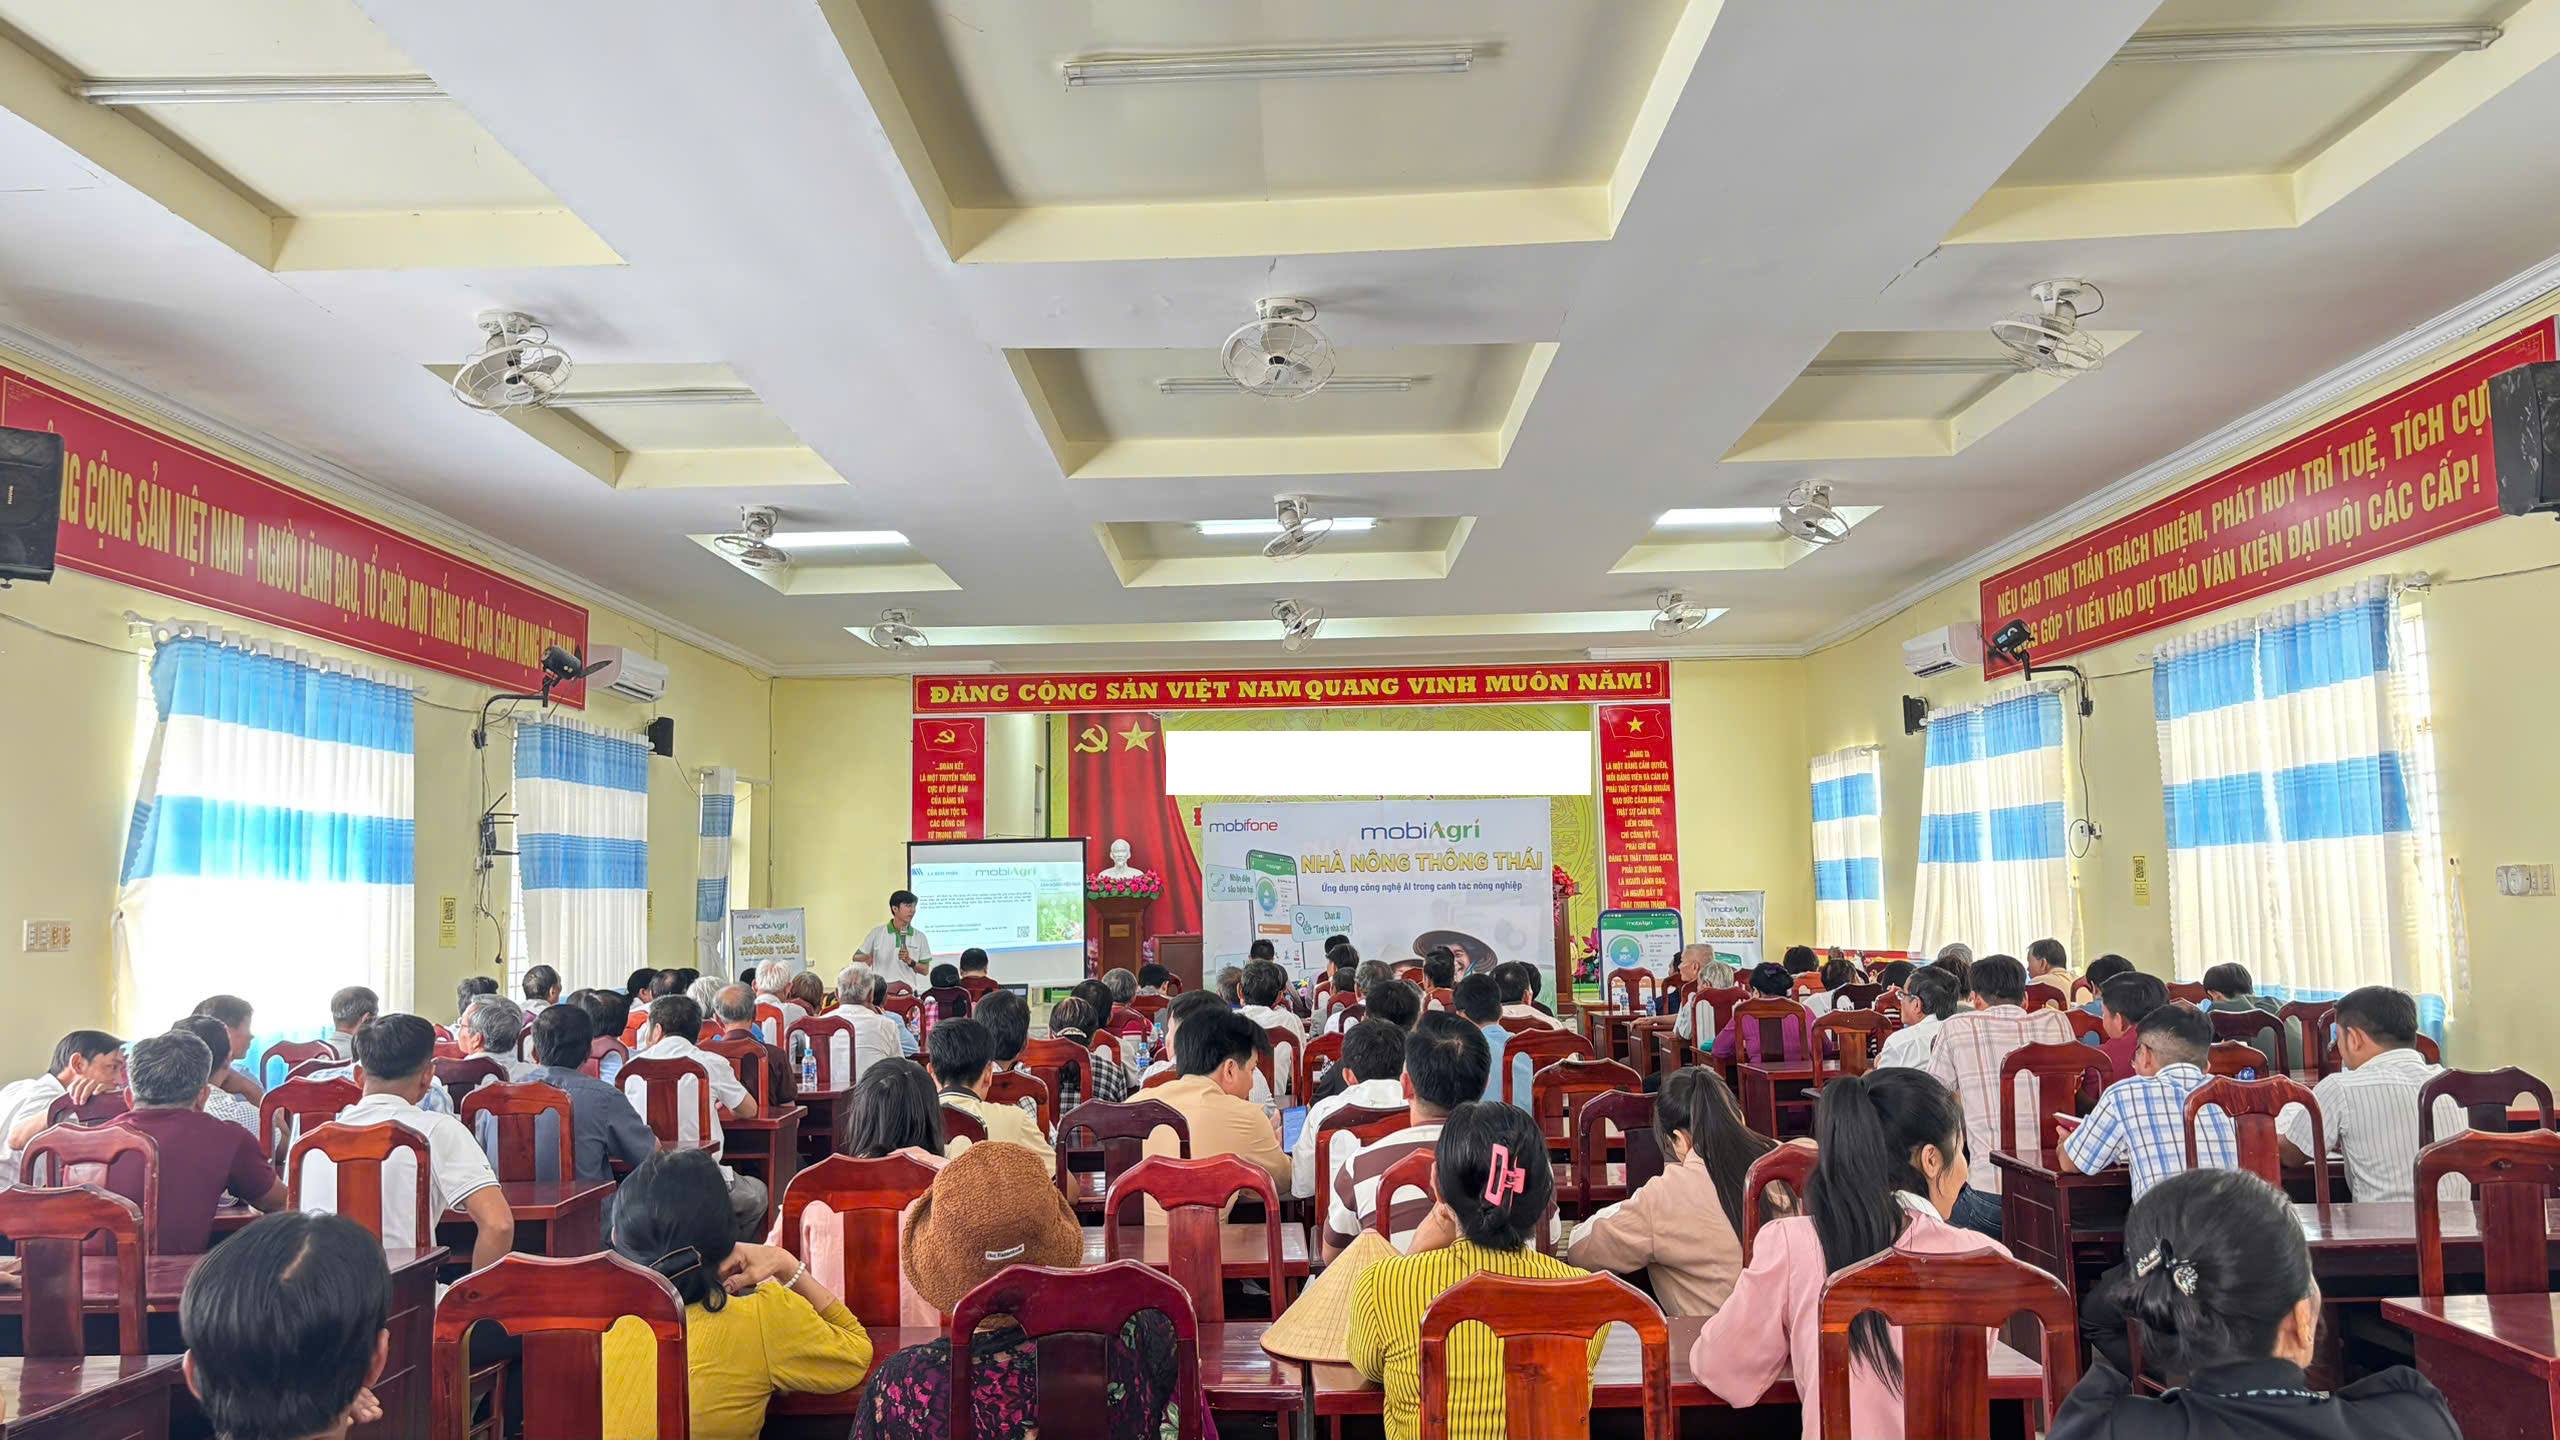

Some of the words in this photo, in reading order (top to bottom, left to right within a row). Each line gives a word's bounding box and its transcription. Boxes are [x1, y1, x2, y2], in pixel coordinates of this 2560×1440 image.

[1997, 586, 2018, 618] NÊU
[2020, 578, 2041, 609] CAO
[2043, 566, 2070, 600] TINH
[2072, 547, 2105, 590] THẦN
[2106, 534, 2150, 575] TRÁCH
[2153, 510, 2208, 558] NHIỆM,
[2211, 484, 2255, 534] PHÁT
[2260, 468, 2296, 514] HUY
[2301, 445, 2334, 497] TRÍ
[2338, 426, 2386, 481] TUỆ,
[2391, 403, 2445, 461] TÍCH
[2452, 378, 2492, 436] CỰ
[84, 450, 133, 549] CỘNG
[136, 461, 172, 554] SẢN
[175, 485, 208, 577] VIỆT
[210, 506, 245, 577] NAM
[257, 518, 298, 594] NGƯỜI
[300, 530, 333, 605] LÃNH
[335, 552, 361, 623] ĐẠO,
[364, 544, 377, 620] TỔ
[380, 563, 407, 629] CHỨC
[409, 579, 429, 646] MỌI
[430, 572, 460, 646] THẮNG
[461, 595, 476, 660] LỢI
[477, 590, 494, 655] CỦA
[495, 602, 517, 663] CÁCH
[517, 618, 540, 677] MẠNG
[2041, 610, 2063, 644] GÓP
[2066, 604, 2073, 636] Ý
[2076, 591, 2105, 633] KIẾN
[2107, 584, 2133, 621] VÀO
[2136, 574, 2156, 615] DỰ
[2158, 557, 2199, 605] THẢO
[2201, 546, 2236, 590] VĂN
[2240, 529, 2284, 577] KIỆN
[2287, 516, 2321, 562] ĐẠI
[2326, 497, 2362, 549] HỘI
[2367, 479, 2414, 532] CÁC
[2420, 450, 2481, 513] CẤP!
[930, 681, 1009, 703] ĐẢNG
[1018, 680, 1097, 704] CỘNG
[1106, 678, 1158, 700] SẢN
[1166, 678, 1229, 702] VIỆT
[1238, 680, 1301, 698] NAM
[1304, 678, 1400, 702] QUANG
[1407, 676, 1477, 694] VINH
[1485, 671, 1569, 693] MUÔN
[1577, 669, 1652, 691] NĂM!
[1209, 818, 1278, 833] mobifone
[1300, 849, 1346, 874] NHÀ
[1350, 848, 1411, 872] NÔNG
[1415, 847, 1489, 871] THÔNG
[1493, 846, 1543, 871] THÁI
[1321, 881, 1337, 894] Ứng
[1338, 883, 1359, 894] dụng
[1360, 883, 1380, 893] công
[1381, 883, 1402, 893] nghệ
[1413, 883, 1435, 892] trong
[1436, 882, 1456, 890] canh
[1458, 882, 1471, 890] tác
[1473, 881, 1493, 892] nông
[1495, 881, 1522, 892] nghiệp
